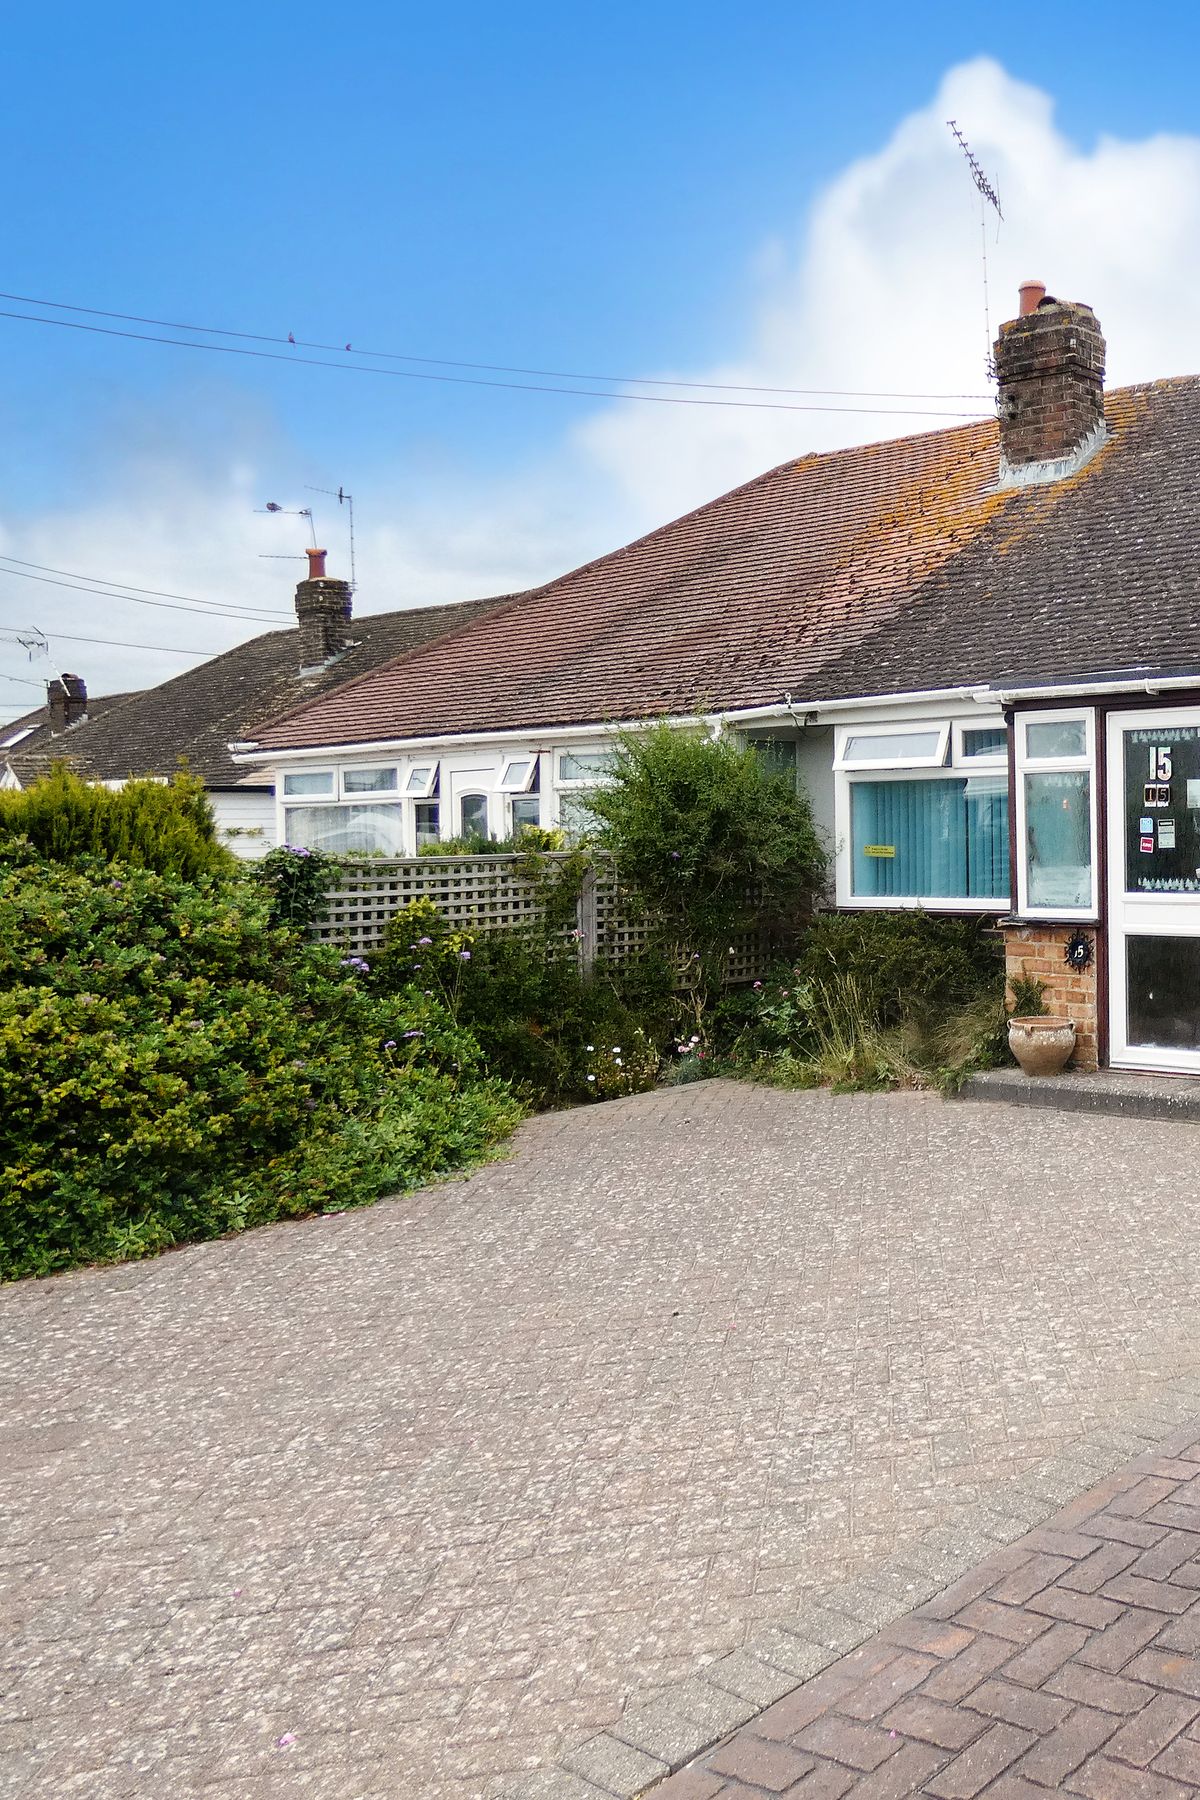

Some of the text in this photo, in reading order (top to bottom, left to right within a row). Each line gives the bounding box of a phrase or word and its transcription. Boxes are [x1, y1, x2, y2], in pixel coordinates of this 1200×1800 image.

[1149, 746, 1172, 781] 15
[1147, 788, 1168, 801] 15
[1074, 945, 1084, 958] 15
